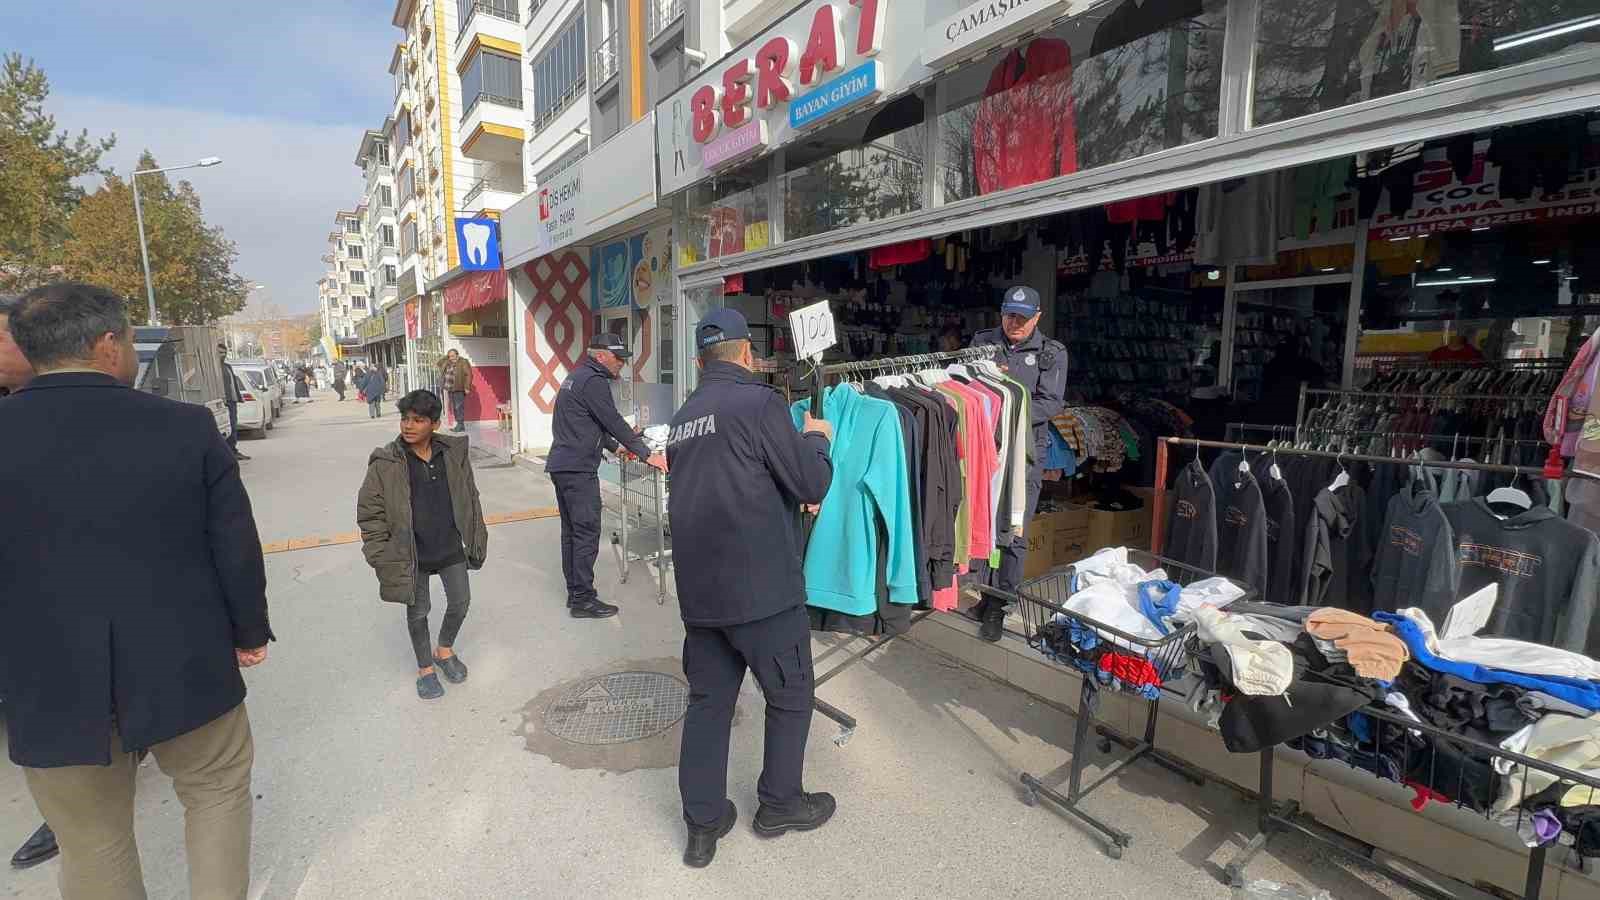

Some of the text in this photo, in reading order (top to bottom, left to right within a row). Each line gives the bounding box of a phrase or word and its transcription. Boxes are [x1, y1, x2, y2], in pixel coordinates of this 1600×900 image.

[691, 0, 880, 143] BERAT
[795, 74, 868, 120] BAYAN GİYİM
[1377, 200, 1503, 223] PJAMA
[799, 312, 828, 350] 100
